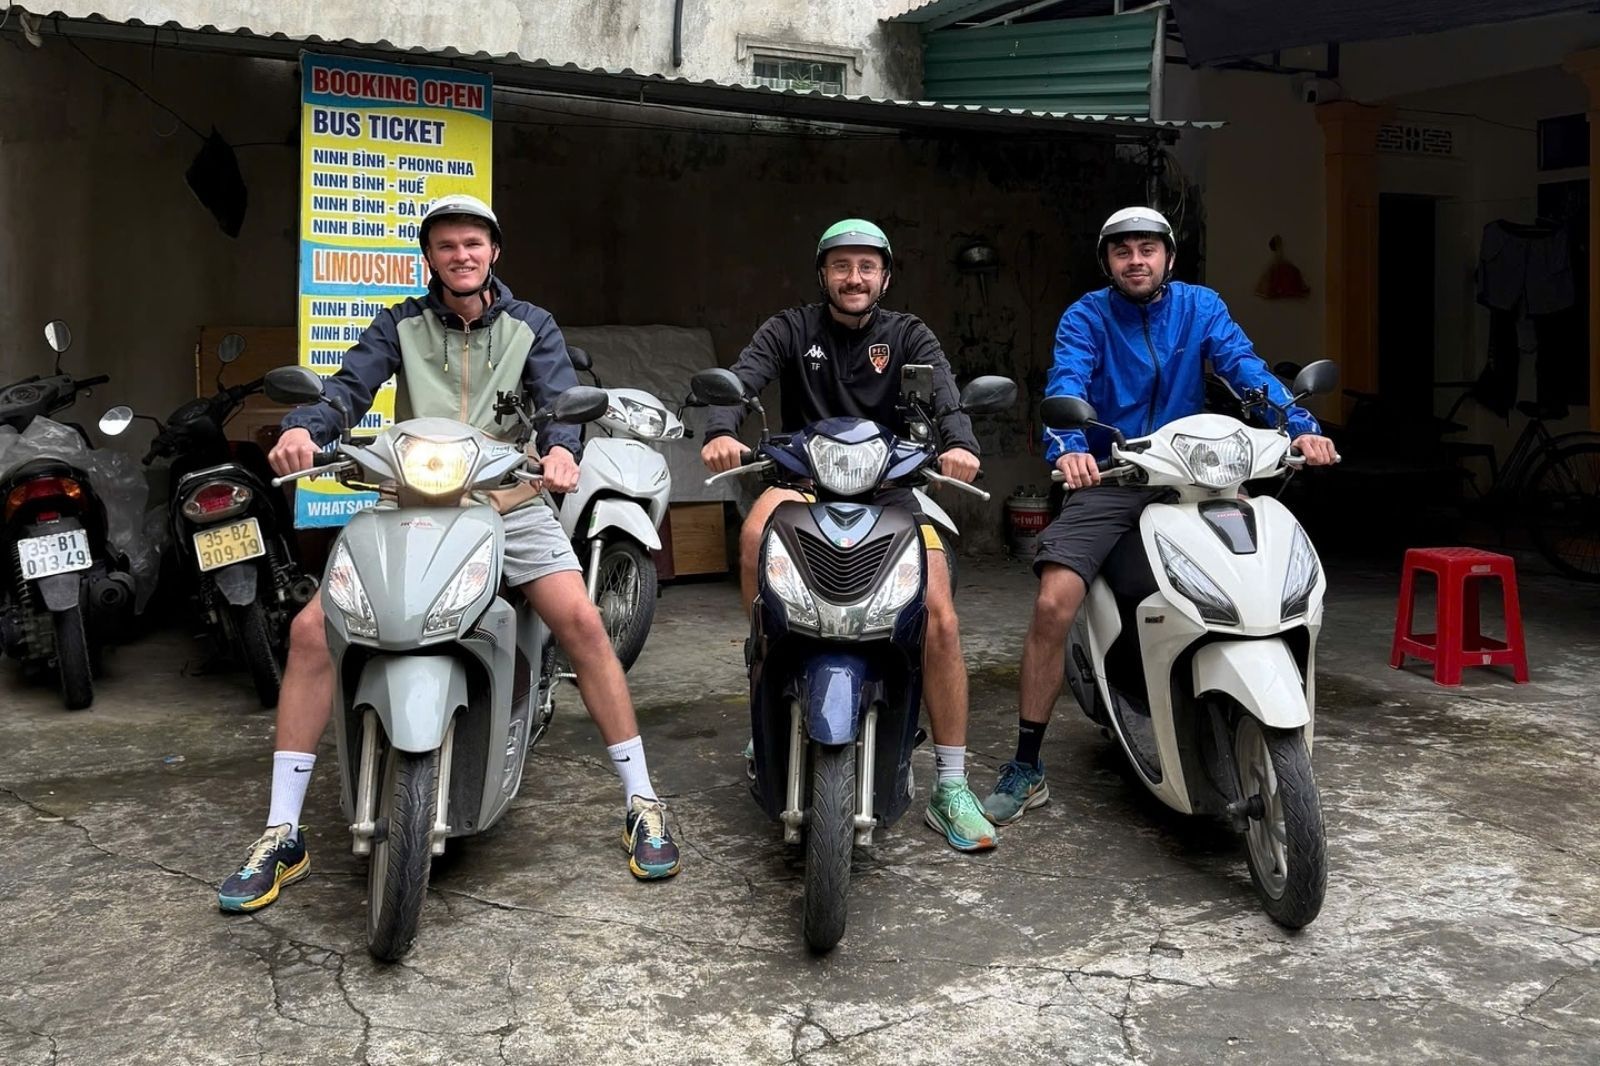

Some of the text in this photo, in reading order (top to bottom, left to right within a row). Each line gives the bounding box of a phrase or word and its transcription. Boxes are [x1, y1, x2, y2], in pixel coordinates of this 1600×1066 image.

[313, 67, 483, 109] BOOKING OPEN
[313, 109, 445, 145] BUS TICKET
[313, 149, 348, 166] NINH
[352, 150, 385, 168] BÌNH
[398, 156, 444, 173] PHONG
[447, 160, 475, 176] NHA
[313, 172, 348, 188] NINH
[352, 174, 385, 191] BÌNH
[398, 177, 425, 194] HUẾ
[313, 195, 348, 211] NINH
[352, 197, 385, 214] BÌNH
[398, 200, 416, 216] ĐÀ
[313, 219, 348, 235] NINH
[352, 220, 385, 237] BÌNH
[314, 250, 416, 285] LIMOUSINE
[312, 301, 347, 316] NINH
[311, 326, 340, 341] NINH
[28, 534, 77, 557] 35-B1
[204, 523, 251, 548] 35-B2
[26, 550, 86, 576] 013.49
[203, 538, 260, 567] 309.19
